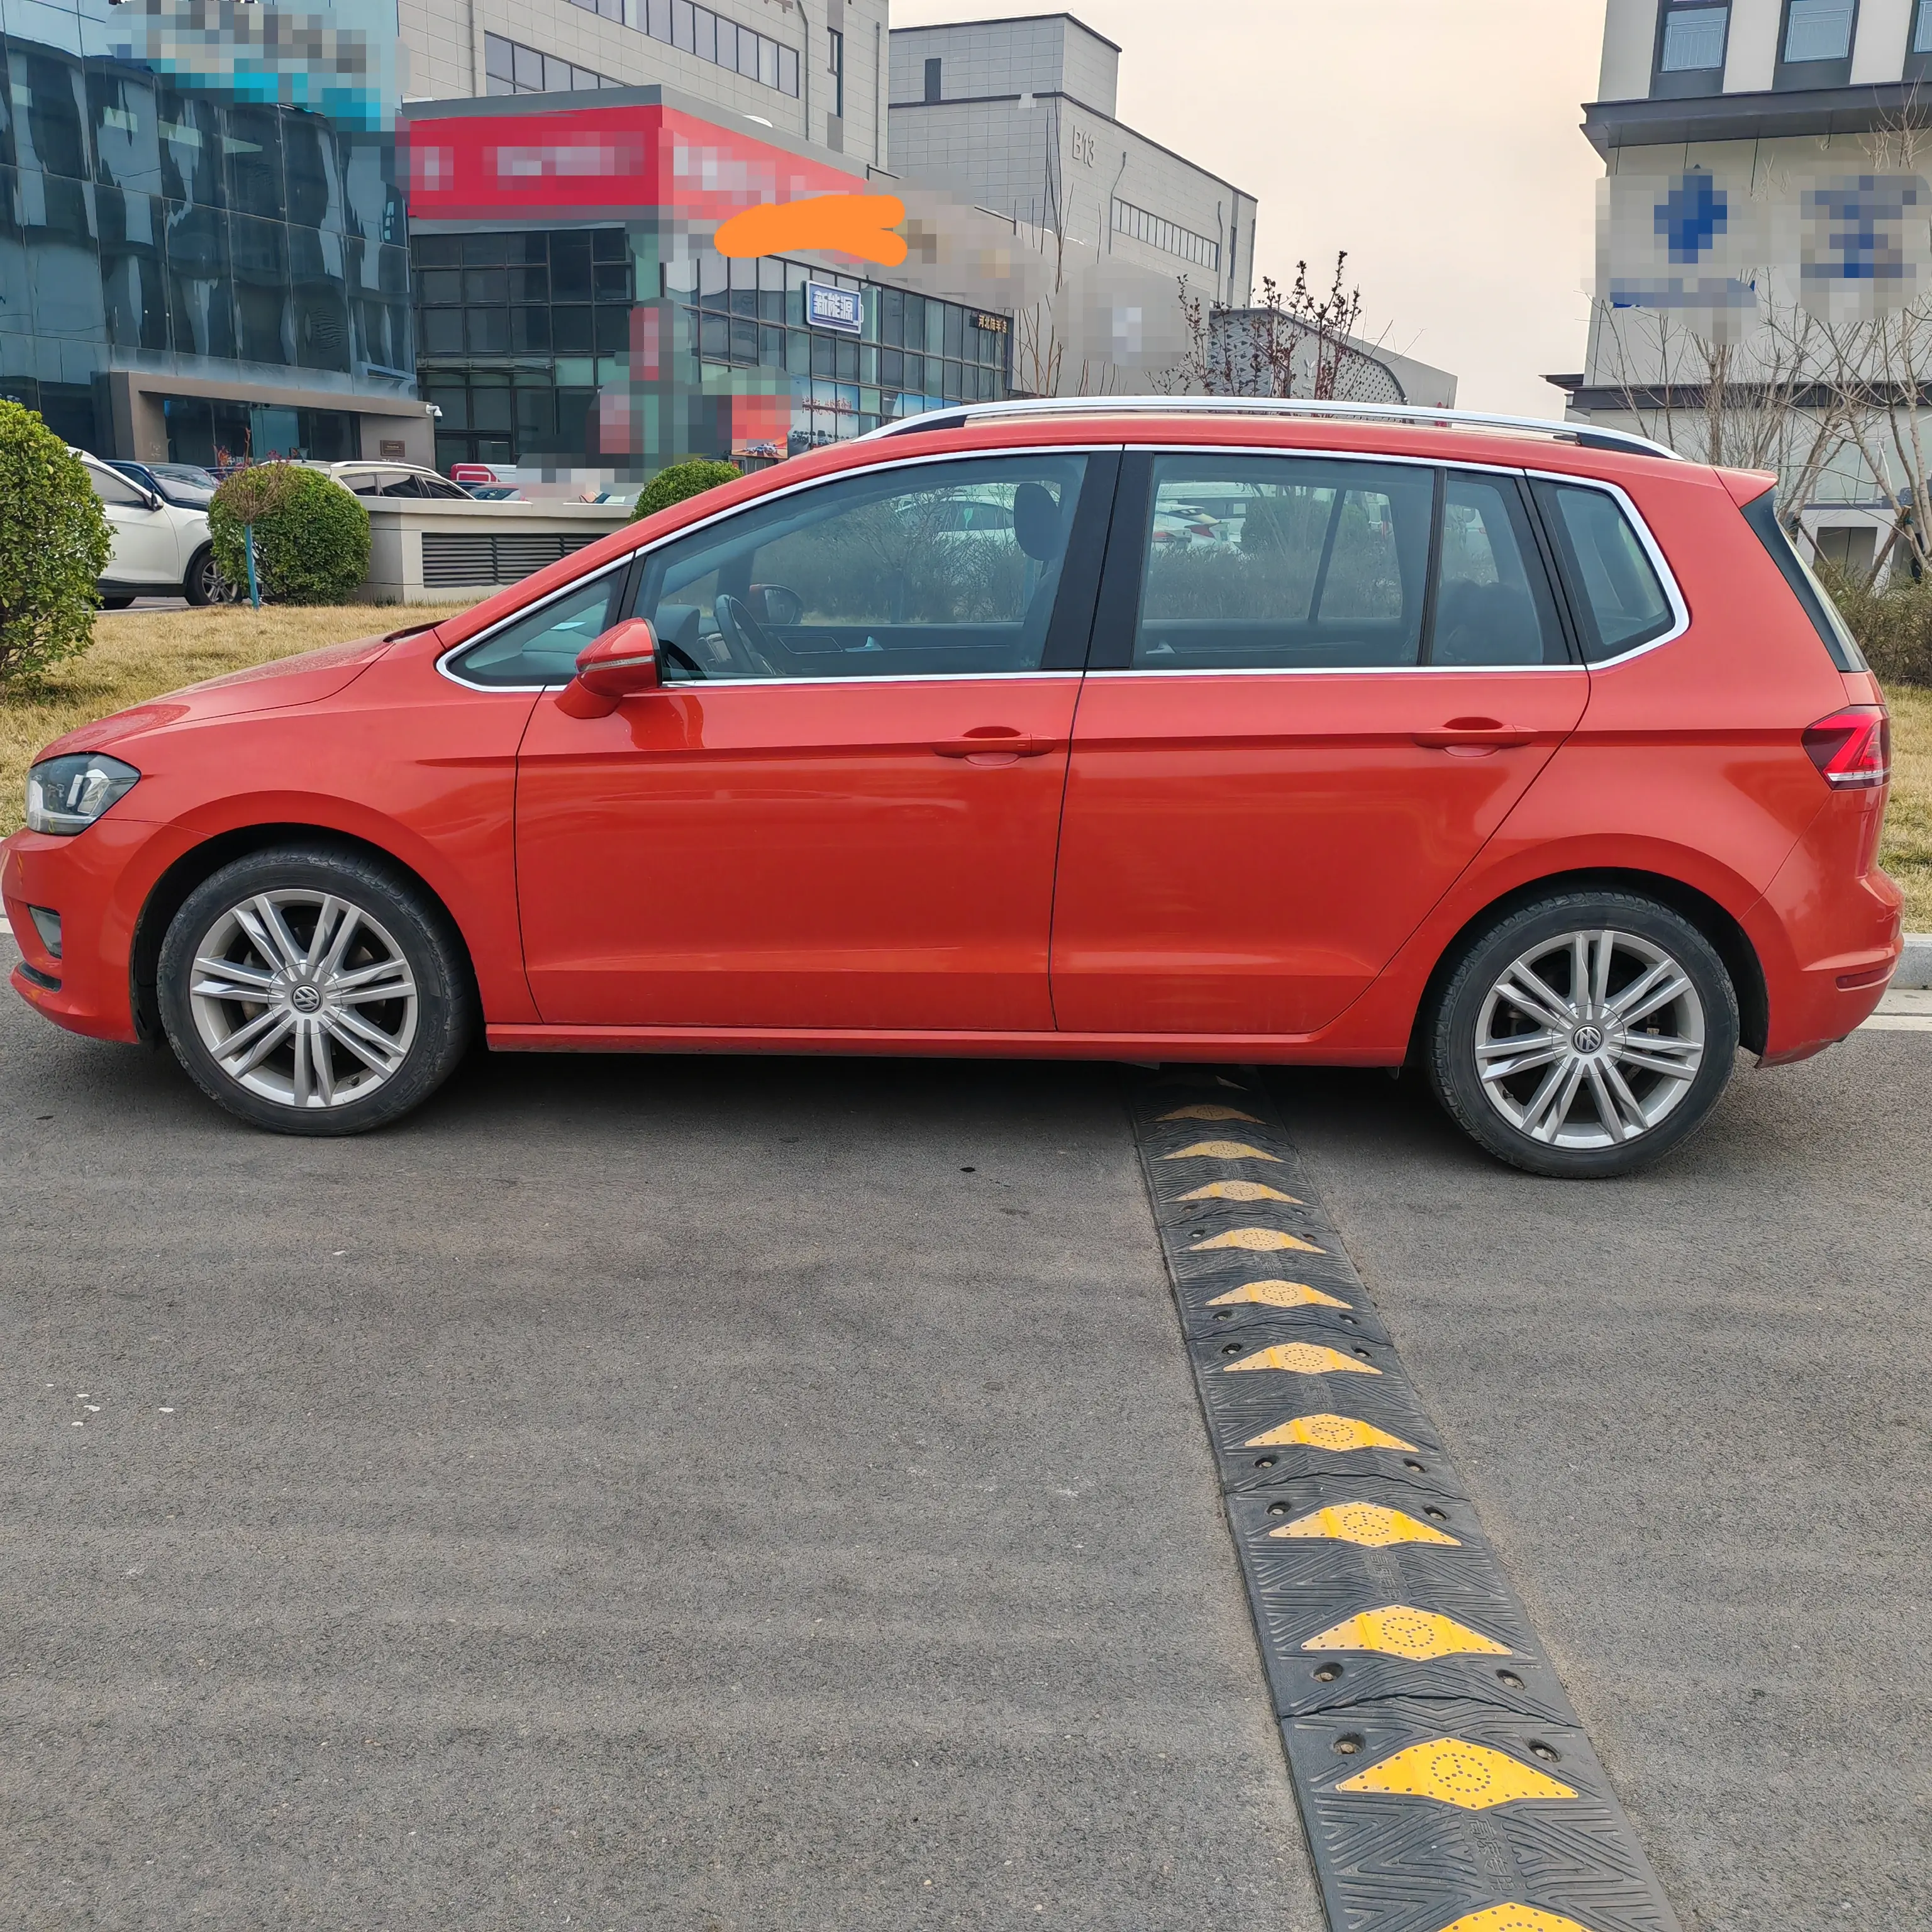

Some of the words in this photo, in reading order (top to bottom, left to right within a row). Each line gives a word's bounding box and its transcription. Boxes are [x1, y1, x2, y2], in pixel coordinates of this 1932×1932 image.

[1072, 124, 1095, 169] B13
[813, 289, 853, 322] 新能源
